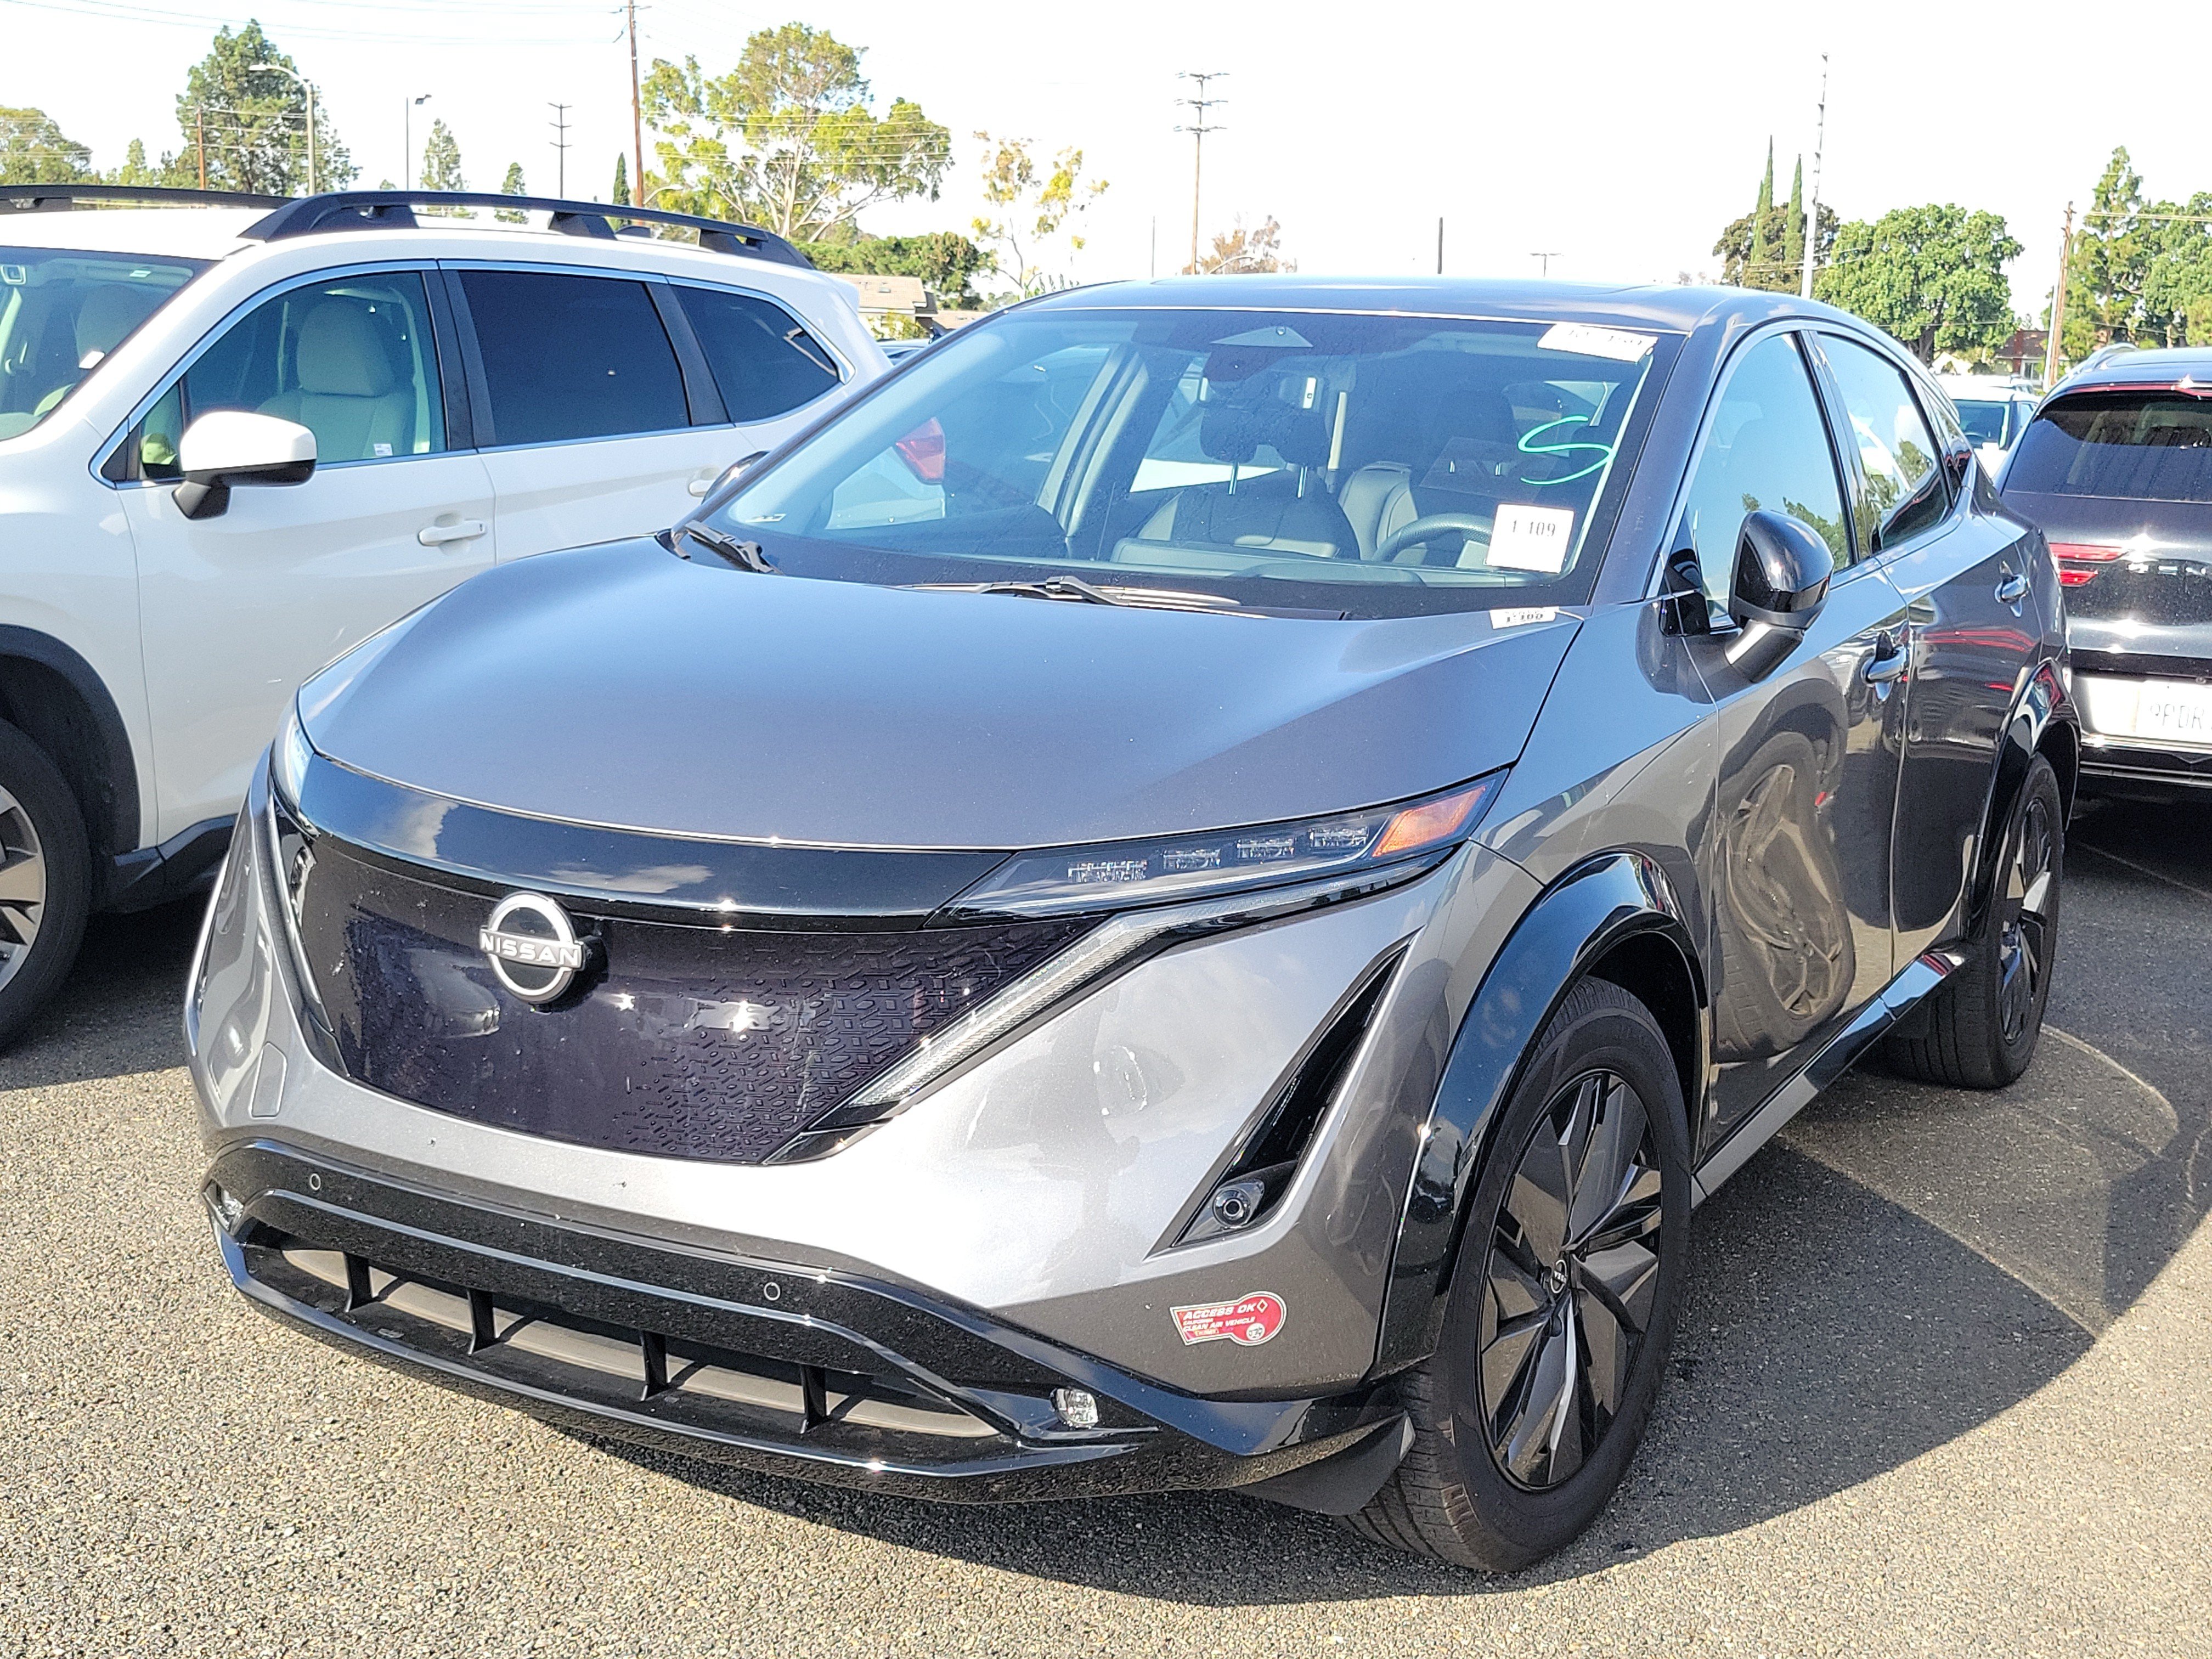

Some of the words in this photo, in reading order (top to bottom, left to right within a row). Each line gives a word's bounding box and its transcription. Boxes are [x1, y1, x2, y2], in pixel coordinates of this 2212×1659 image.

[481, 933, 578, 966] NISSAN
[1183, 1307, 1234, 1320] ACCESS
[1237, 1302, 1257, 1313] OK
[1183, 1323, 1208, 1331] CLEAN
[1225, 1317, 1256, 1327] VEHICLE
